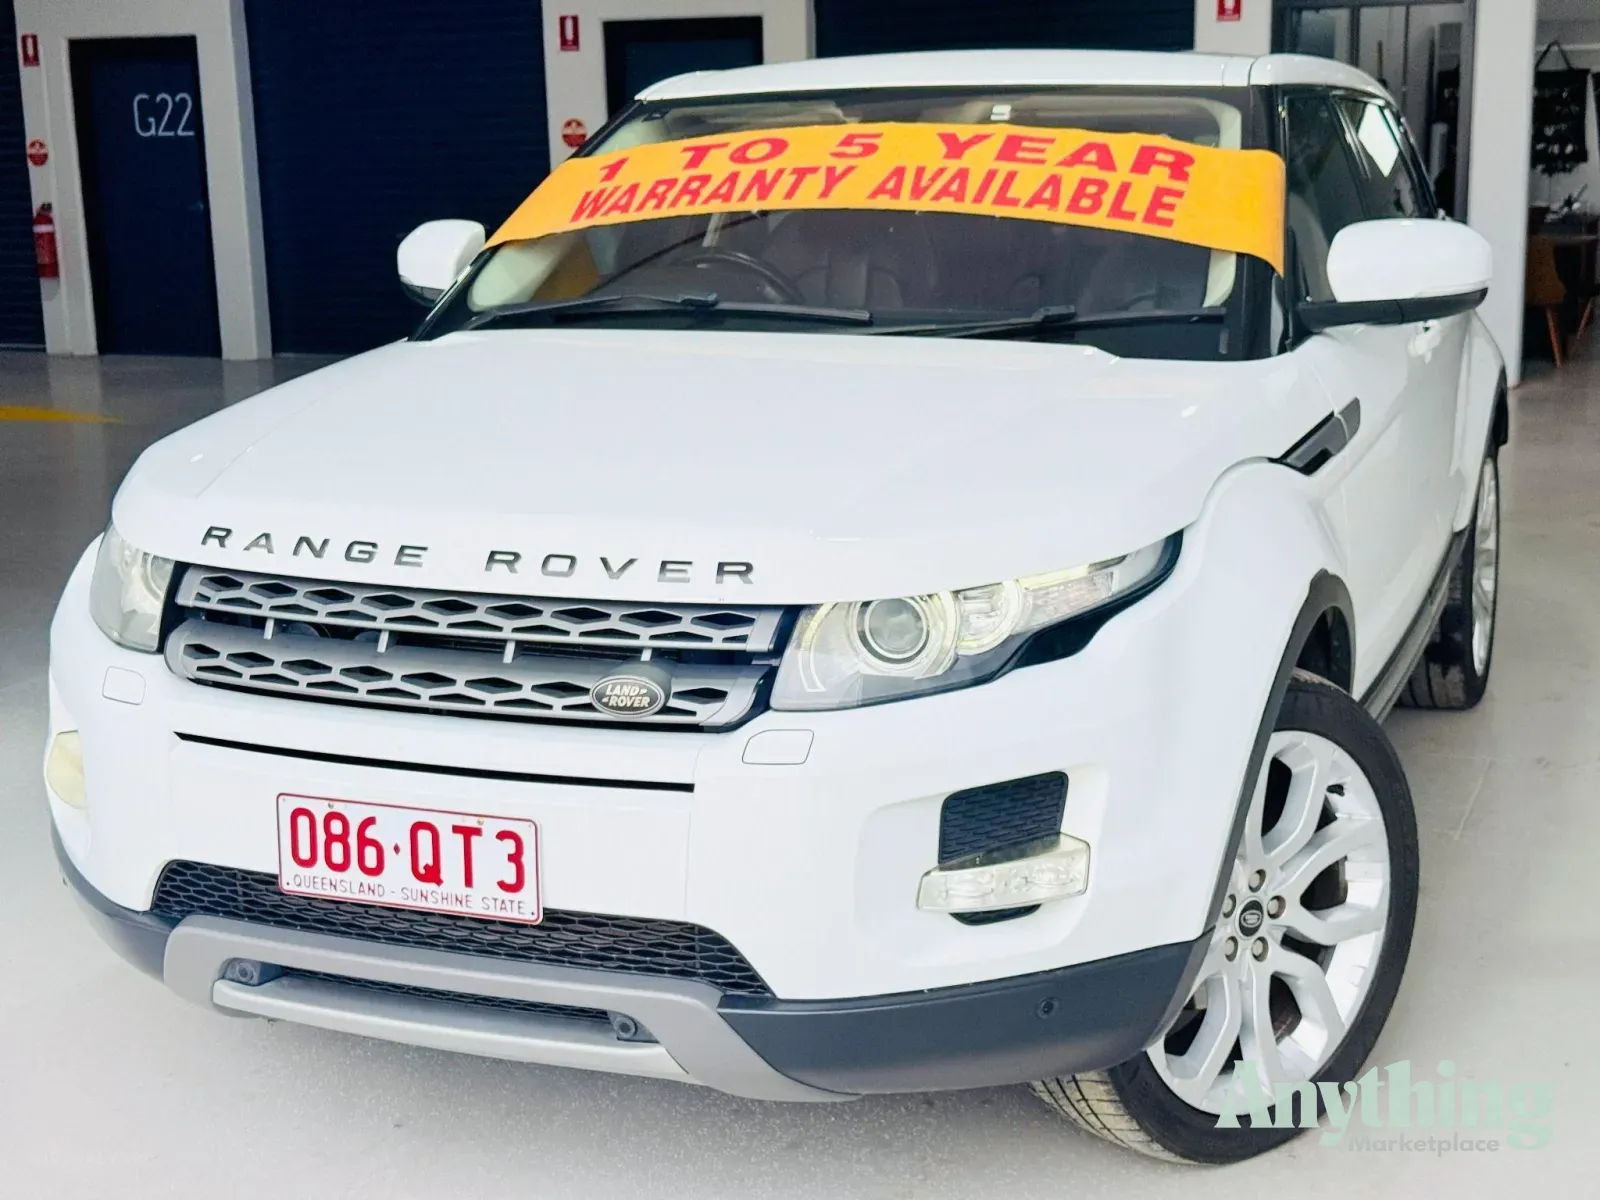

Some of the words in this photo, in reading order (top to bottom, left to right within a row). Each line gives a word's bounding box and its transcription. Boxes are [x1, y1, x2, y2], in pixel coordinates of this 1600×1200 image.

[133, 92, 195, 138] G22
[599, 157, 630, 182] 1
[680, 137, 790, 171] TO
[828, 132, 884, 160] 5
[936, 131, 1196, 182] YEAR
[569, 165, 859, 224] WARRANTY
[867, 165, 1186, 227] AVAILABLE
[200, 525, 430, 568] RANGE
[484, 549, 755, 585] ROVER
[605, 684, 640, 696] LAND
[608, 695, 650, 708] ROVER
[293, 874, 385, 898] QUEENSLAND
[400, 886, 474, 909] SUNSHINE
[481, 897, 526, 915] STATE
